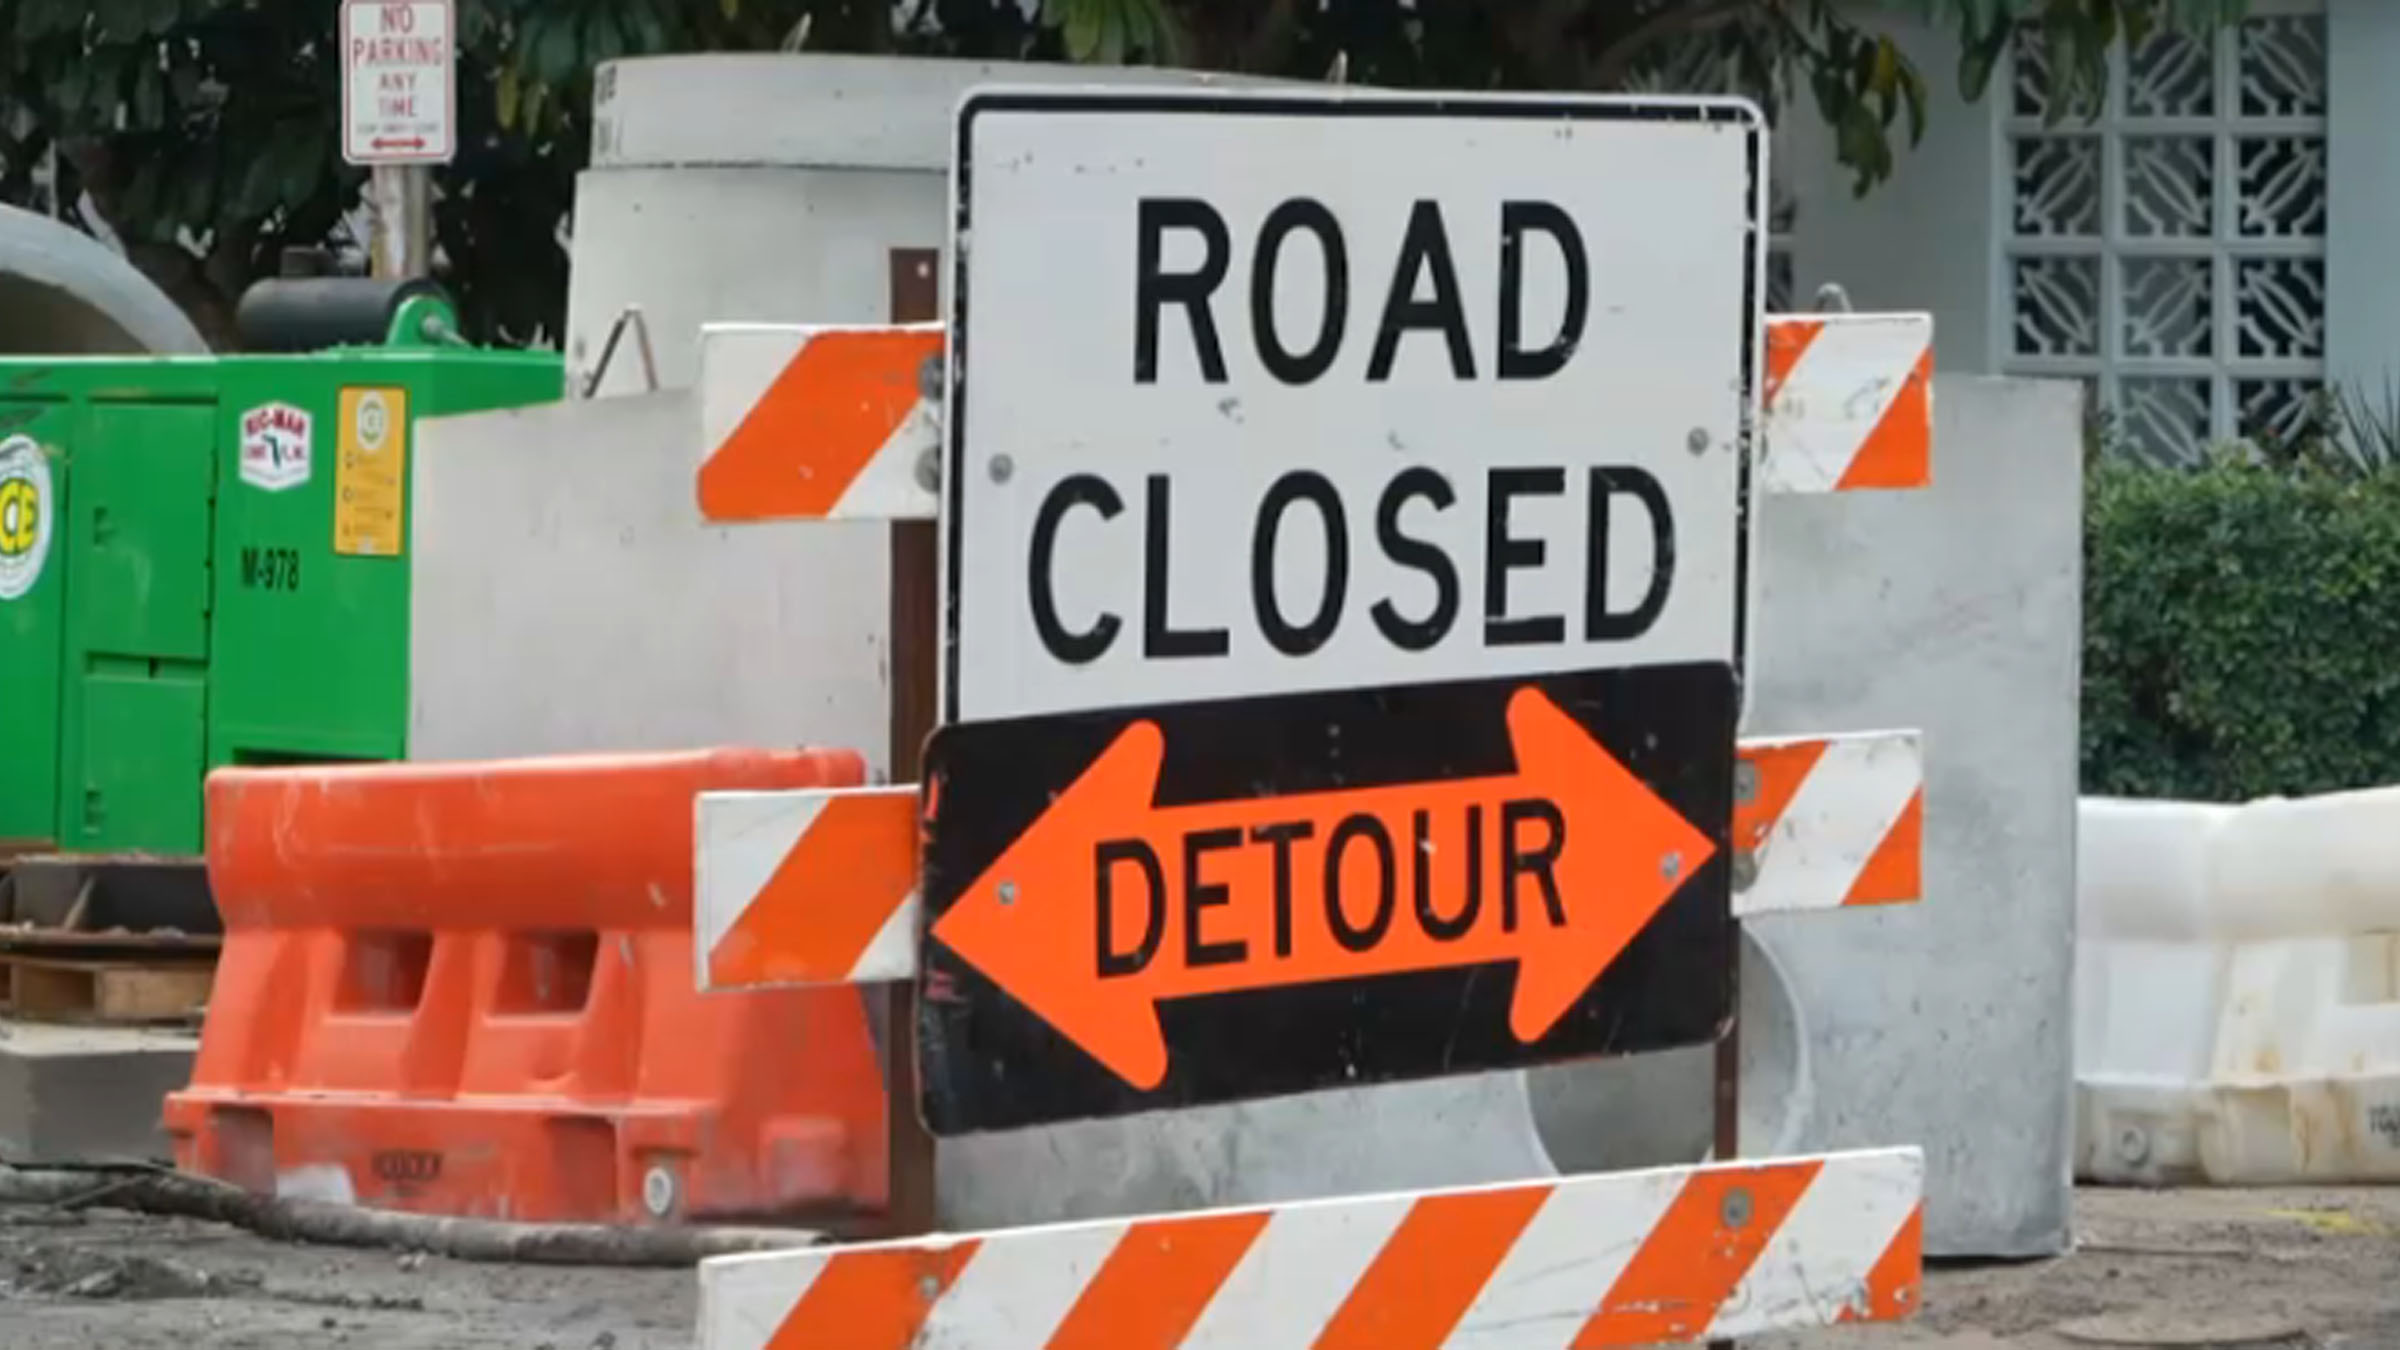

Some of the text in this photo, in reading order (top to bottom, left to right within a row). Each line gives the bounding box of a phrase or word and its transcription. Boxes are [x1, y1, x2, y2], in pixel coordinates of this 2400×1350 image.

[379, 4, 414, 34] NO
[353, 36, 442, 67] PARKING
[379, 73, 417, 90] ANY
[378, 95, 417, 118] TIME
[1135, 198, 1588, 385] ROAD
[240, 547, 300, 592] M-978
[1029, 466, 1674, 665] CLOSED
[1095, 797, 1567, 980] DETOUR
